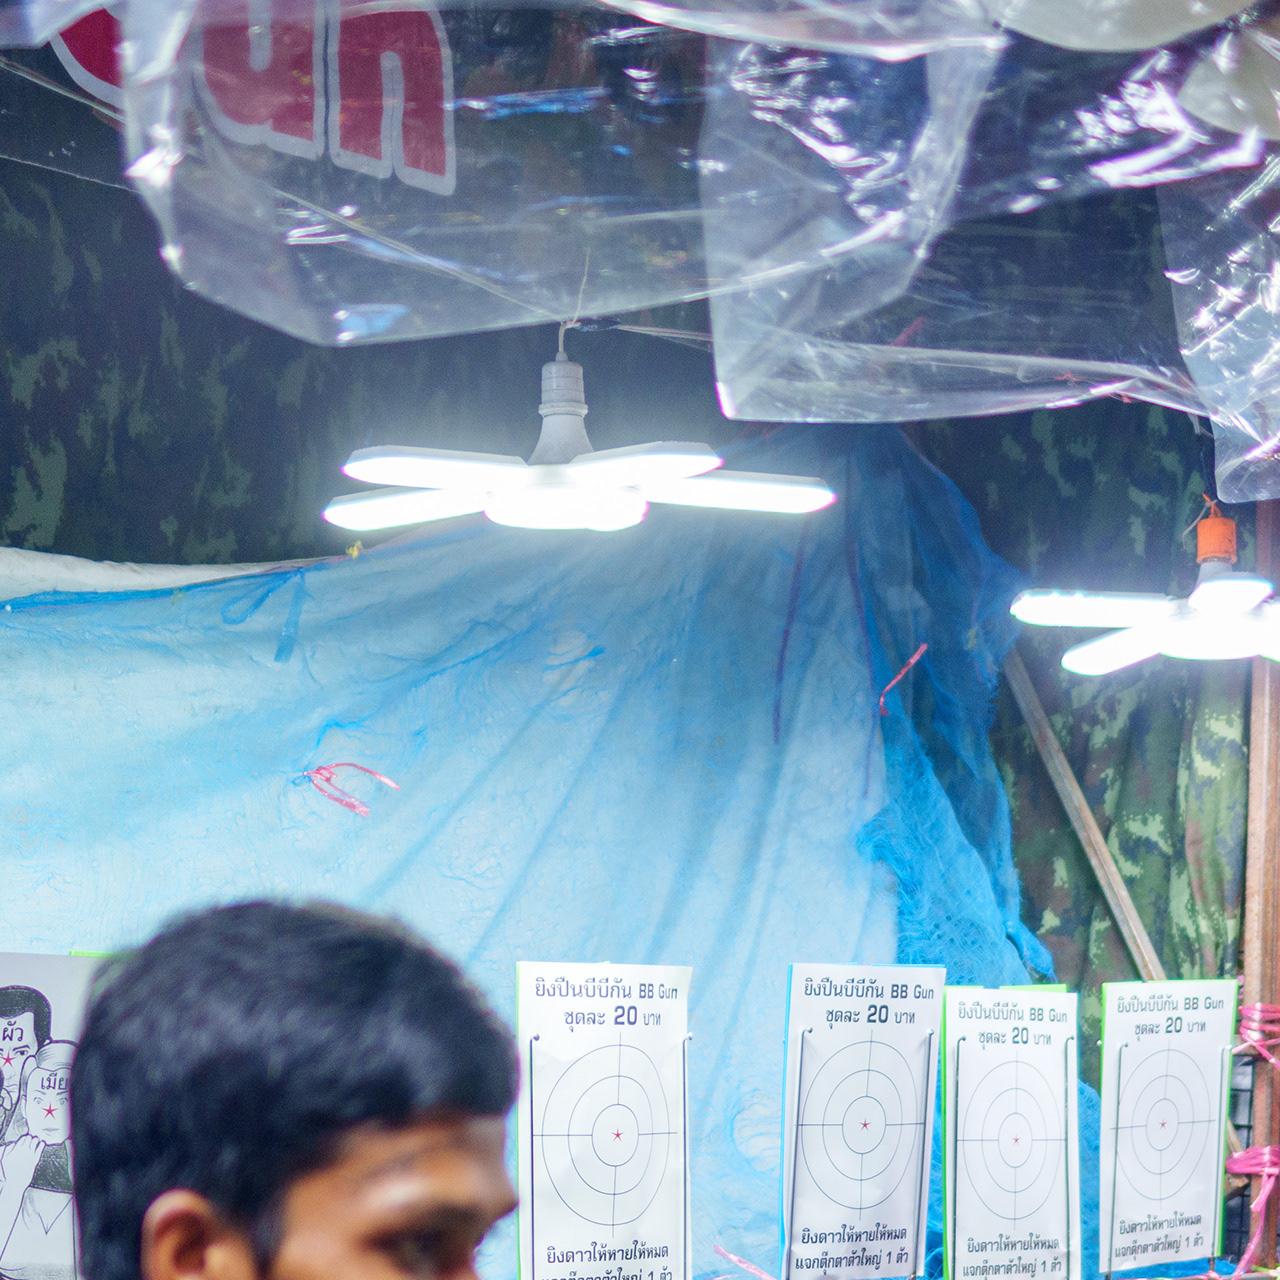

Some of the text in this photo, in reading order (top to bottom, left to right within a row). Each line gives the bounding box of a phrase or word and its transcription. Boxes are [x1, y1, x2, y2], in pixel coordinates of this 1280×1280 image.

[48, 0, 457, 196] un
[535, 976, 678, 1000] ยิงปืนบีบีกัน BB Gun
[803, 976, 935, 999] ยิงปืนบีบีกัน BB Gun
[958, 1000, 1068, 1023] ยิงปืนบีบีกัน BB Gun
[1117, 993, 1225, 1014] ยิงปืนบีบีกัน BB Gun
[563, 1005, 662, 1033] ชุดละ 20 บาท
[825, 1003, 916, 1030] ชุดละ 20 บาท
[1, 1020, 24, 1042] ผัว
[978, 1026, 1052, 1051] ชุดละ 20 บาท
[1134, 1016, 1207, 1042] ชุดละ 20 บาท
[40, 1071, 69, 1091] เมีย
[801, 1222, 907, 1245] ยิงดาวให้หายให้หมด
[1184, 1236, 1190, 1248] 1
[1193, 1231, 1204, 1247] ตัว
[546, 1239, 669, 1264] ยิงดาวให้หายให้หมด
[794, 1246, 909, 1276] แจกตุ๊กตาตัวใหญ่ 1 ตัว
[1040, 1260, 1047, 1273] 1
[1050, 1256, 1062, 1273] ตัว
